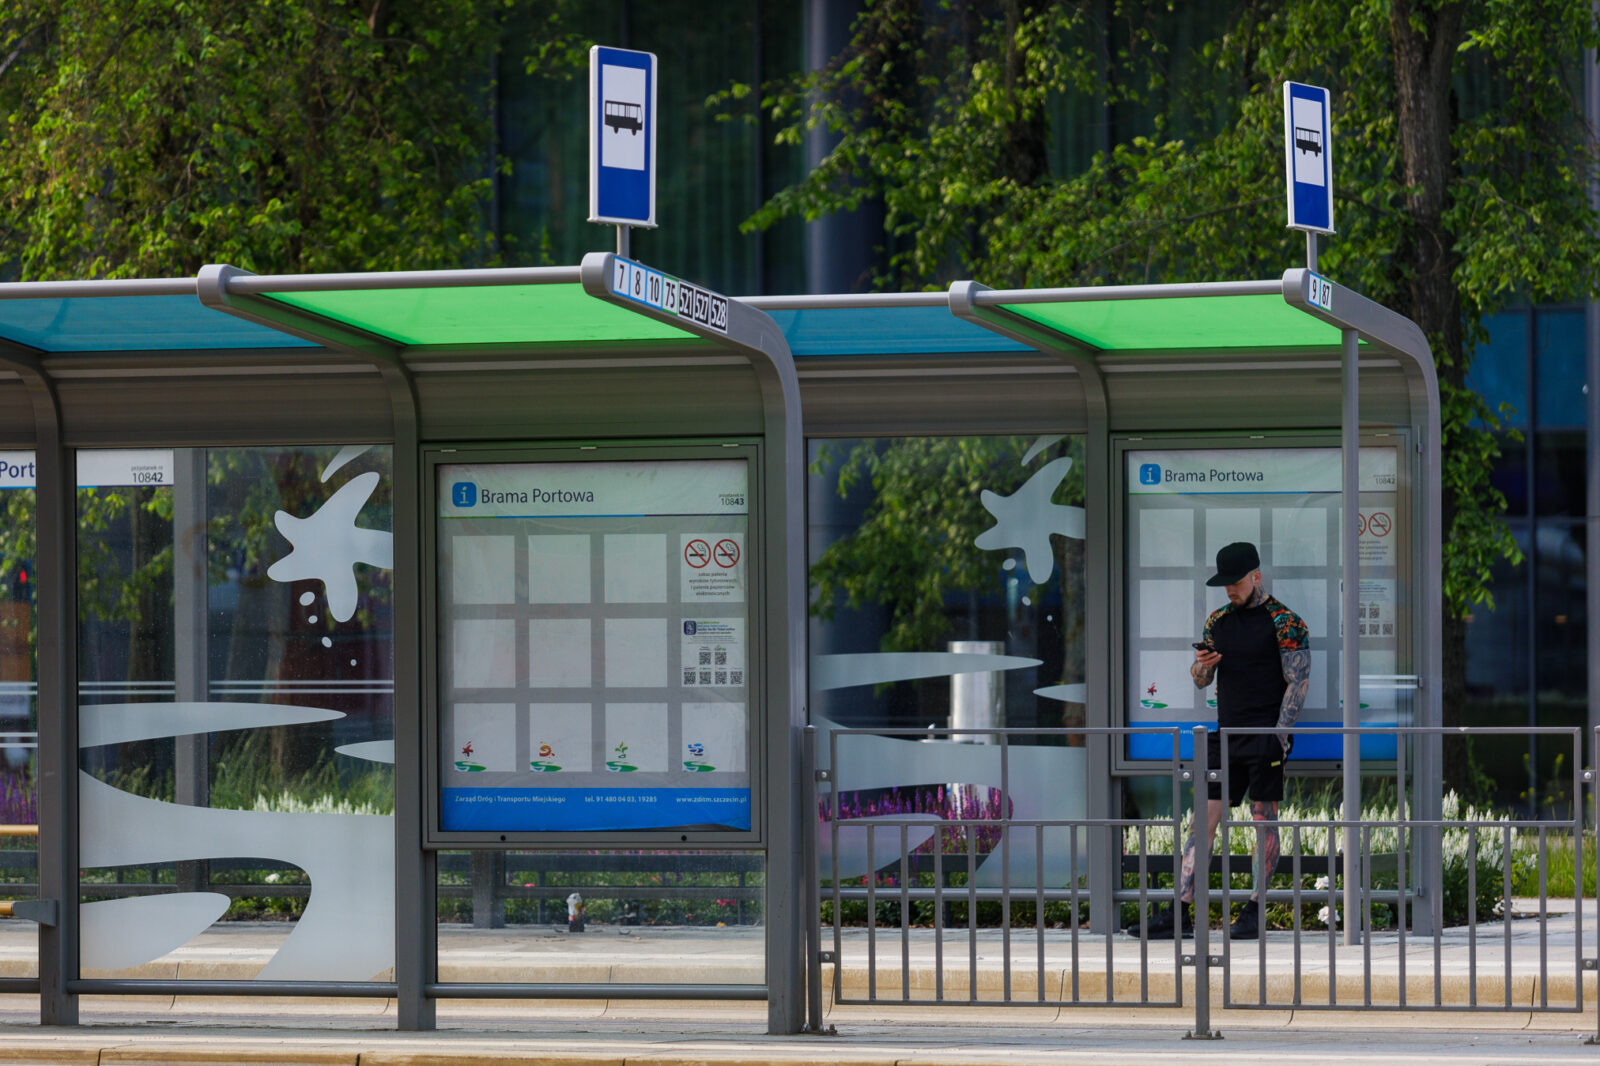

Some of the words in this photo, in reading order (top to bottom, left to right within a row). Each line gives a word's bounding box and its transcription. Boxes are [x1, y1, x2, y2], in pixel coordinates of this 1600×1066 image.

[619, 265, 624, 289] 7
[634, 270, 641, 296] 8
[649, 275, 660, 303] 10
[665, 281, 676, 309] 75
[680, 287, 693, 315] 521
[695, 293, 708, 320] 527
[711, 300, 726, 328] 528
[1313, 279, 1317, 300] 9
[1322, 284, 1330, 305] 87
[0, 460, 35, 478] Port
[132, 471, 163, 483] 10842
[1164, 469, 1206, 482] Brama
[1209, 468, 1264, 482] Portowa
[481, 489, 528, 504] Brama
[532, 488, 594, 503] Portowa
[721, 497, 745, 506] 10843
